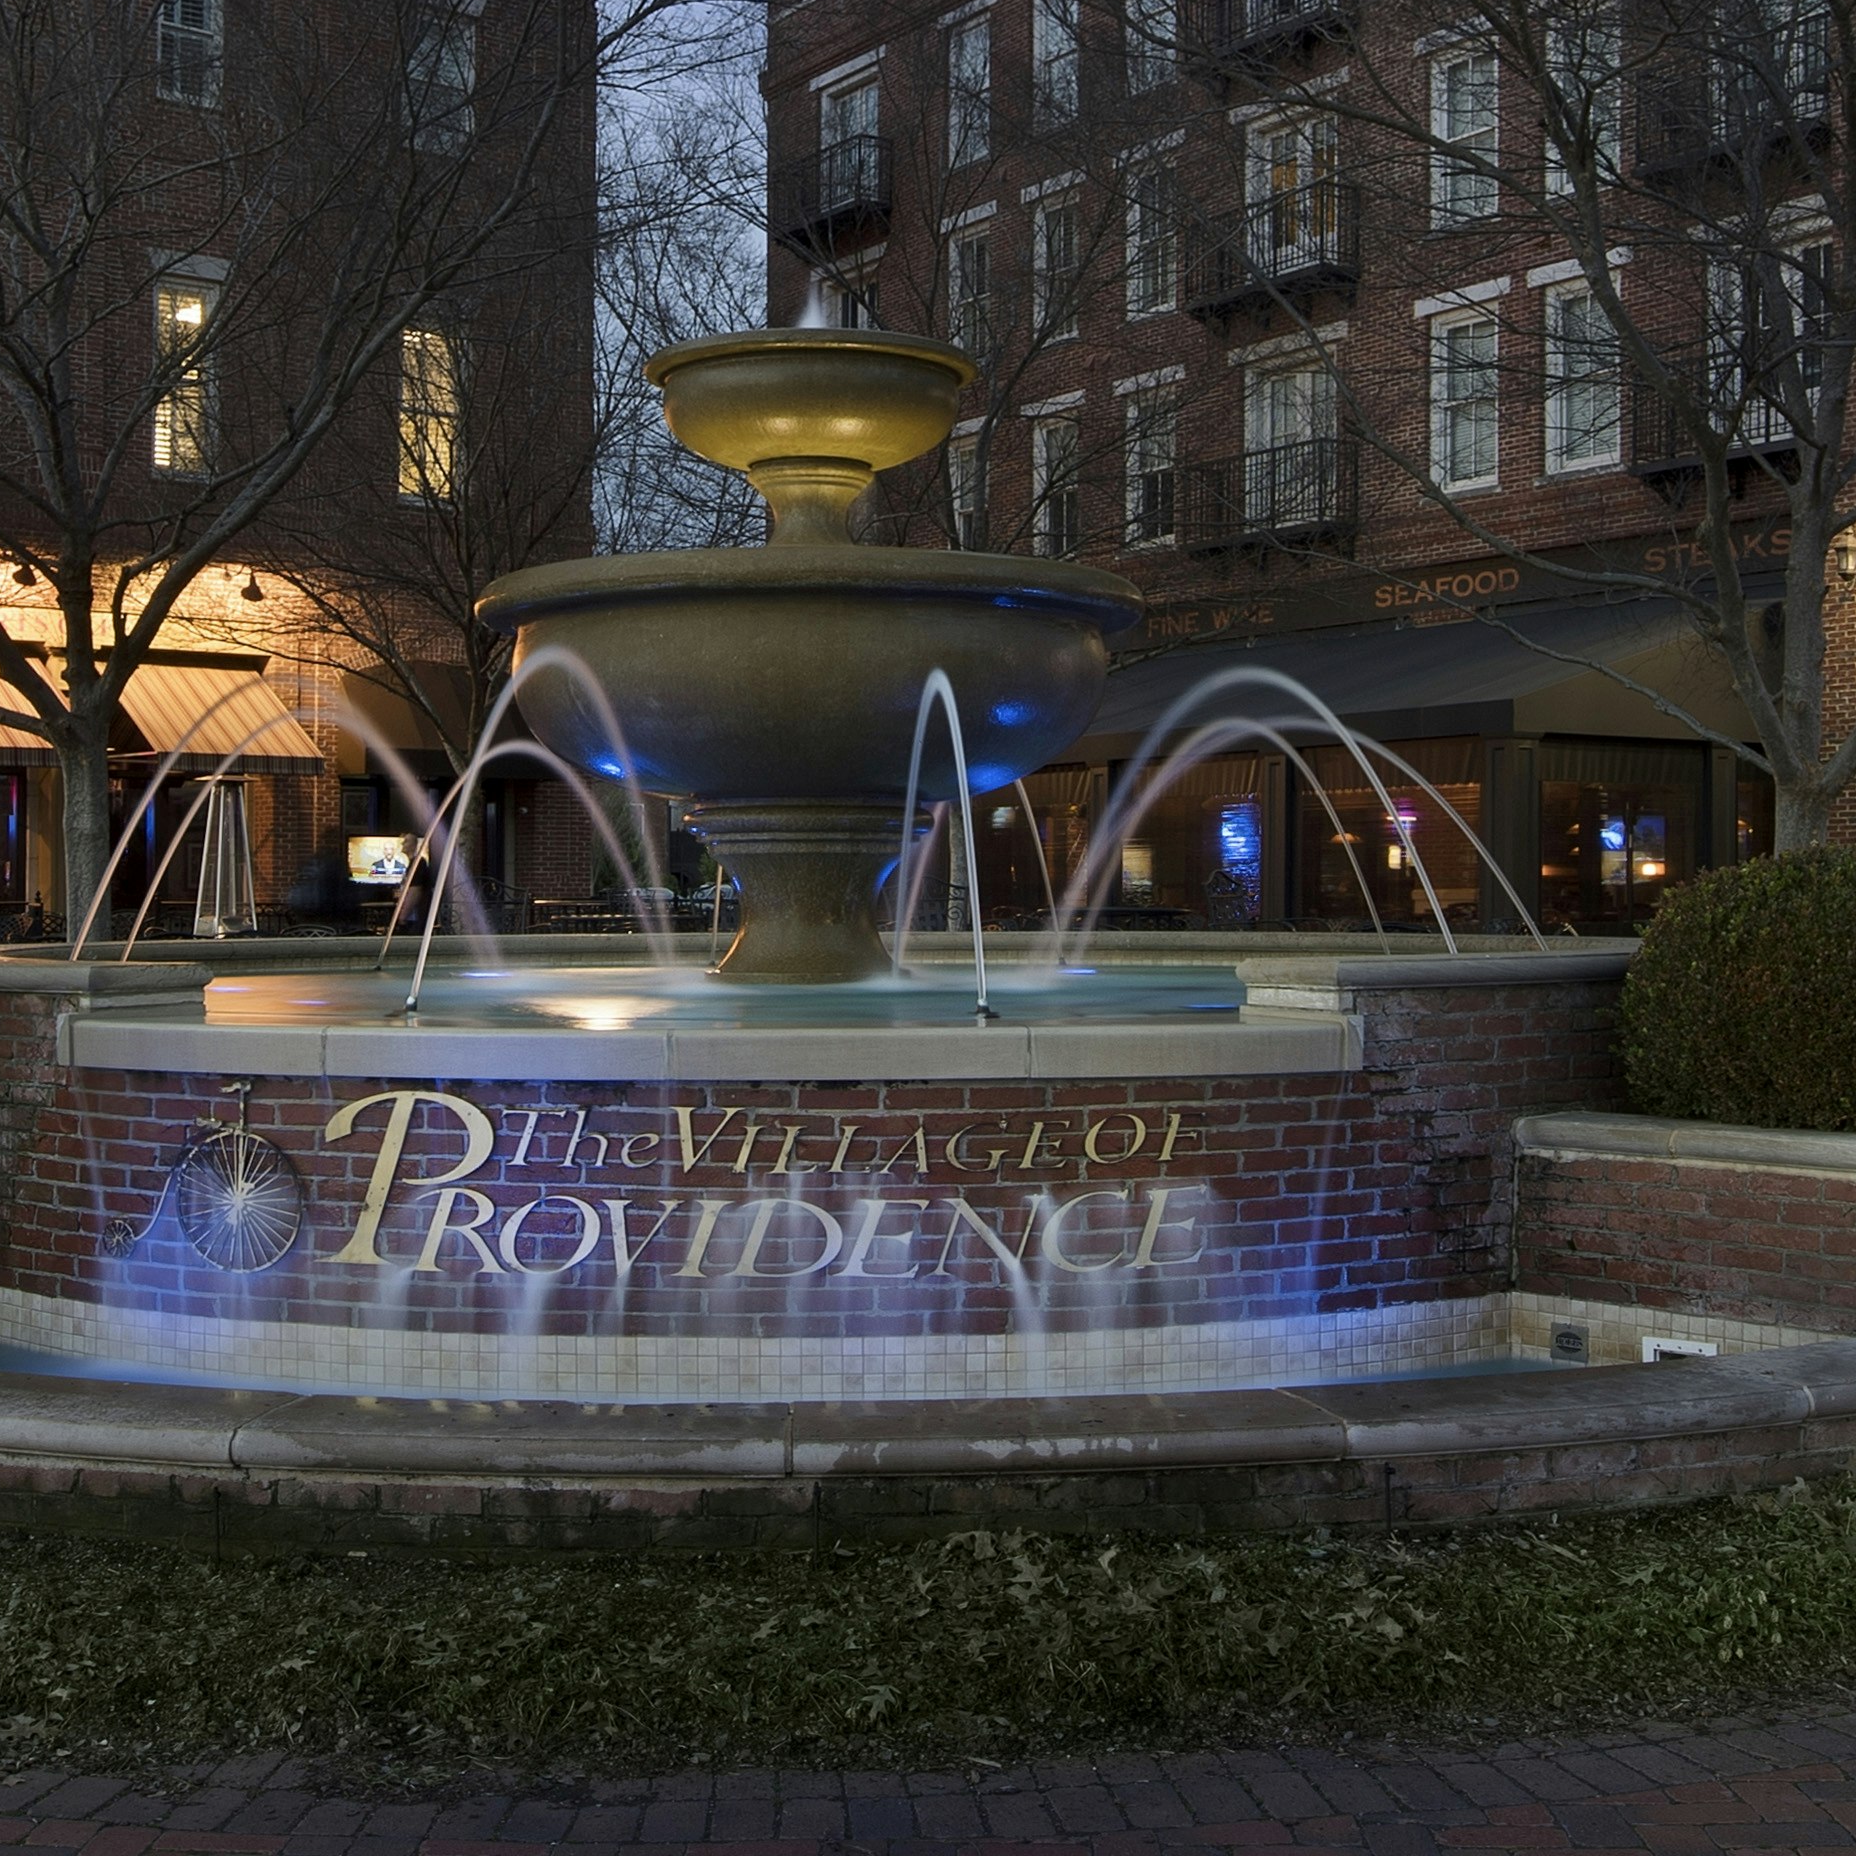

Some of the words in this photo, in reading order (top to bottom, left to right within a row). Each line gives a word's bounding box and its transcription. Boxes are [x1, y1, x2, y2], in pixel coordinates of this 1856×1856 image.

[1644, 528, 1793, 574] STEKS
[1373, 567, 1522, 609] SEAFOOD
[1147, 610, 1200, 638] FINE
[501, 1106, 662, 1169] The
[669, 1106, 1071, 1174] VILLAGE
[1084, 1111, 1208, 1165] OF
[314, 1089, 1209, 1284] PROVIDENCE
